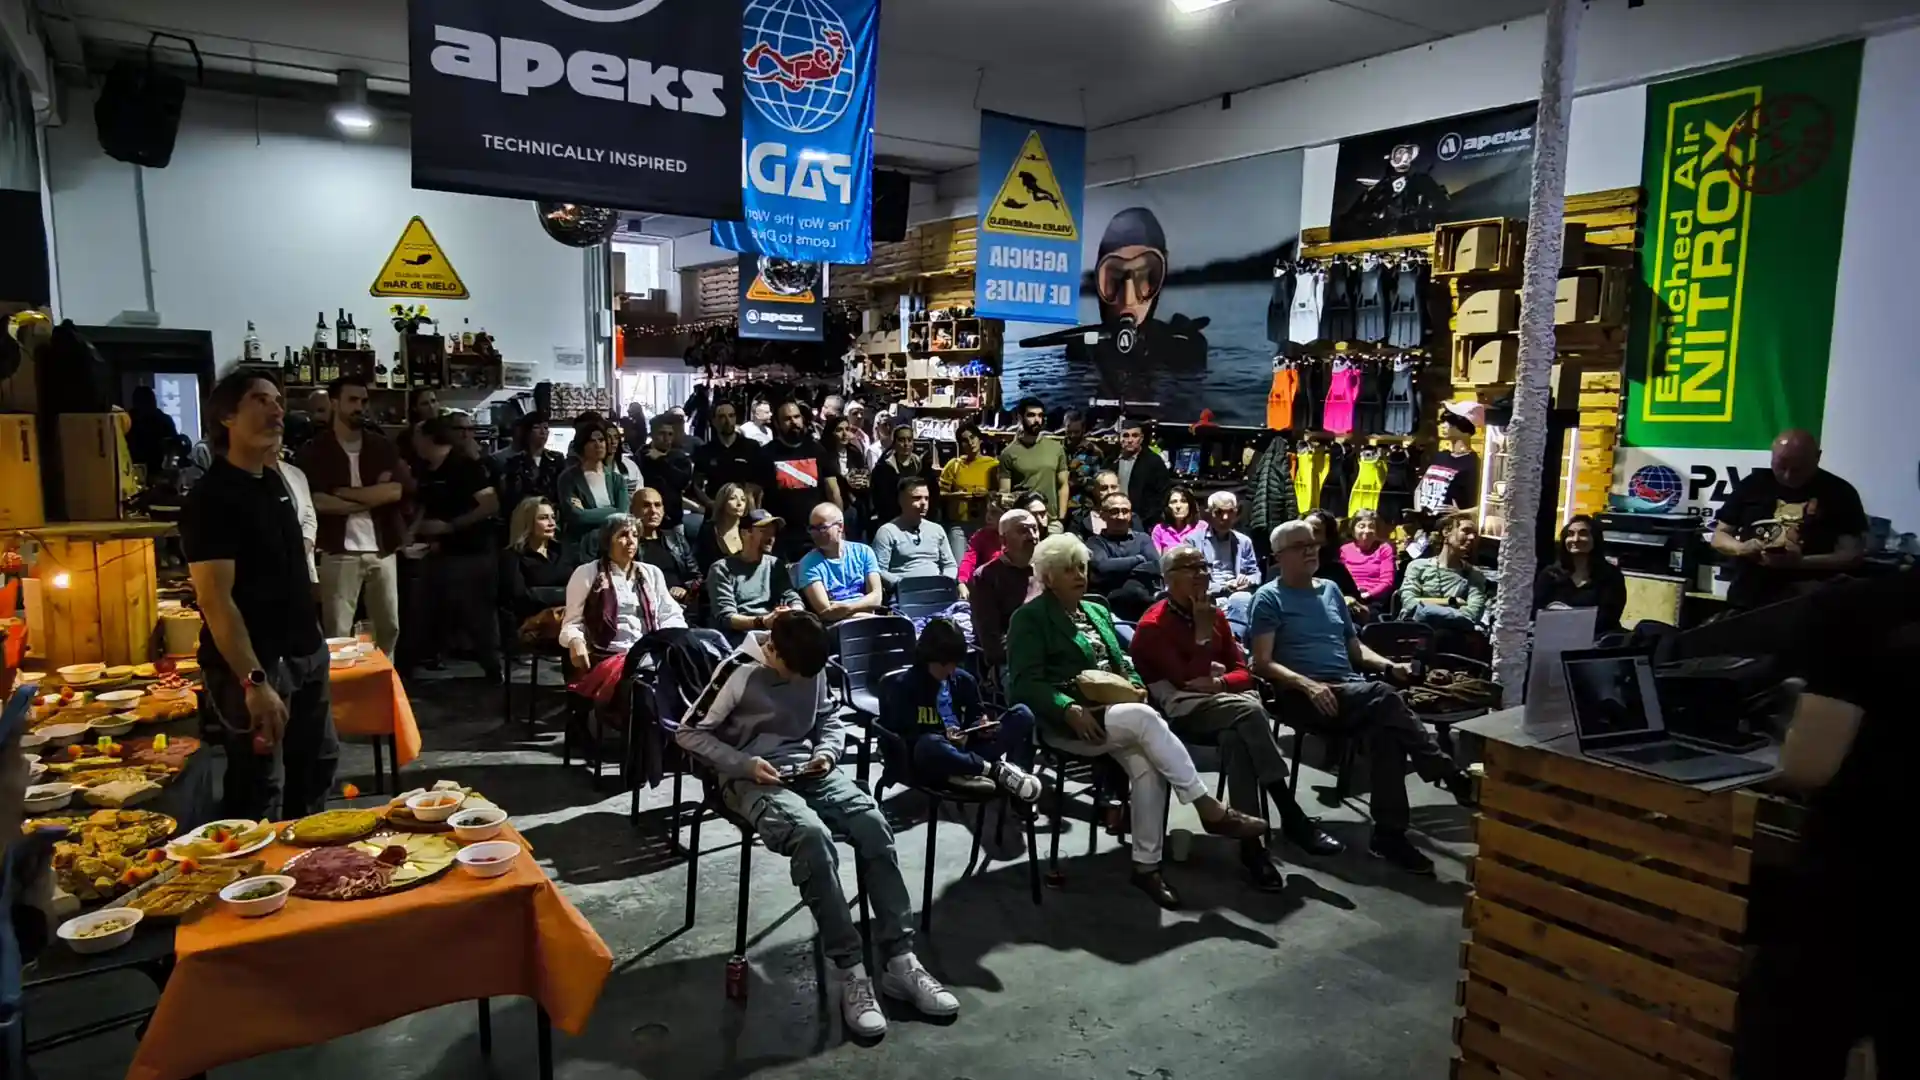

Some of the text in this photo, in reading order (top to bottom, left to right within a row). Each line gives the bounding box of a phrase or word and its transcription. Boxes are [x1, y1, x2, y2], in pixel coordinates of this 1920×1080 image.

[430, 24, 727, 118] apeks
[481, 134, 688, 173] TECHNICALLY INSPIRED
[1463, 127, 1531, 150] apeks
[1655, 121, 1700, 402] Enriched Air
[1680, 109, 1747, 403] NITROX
